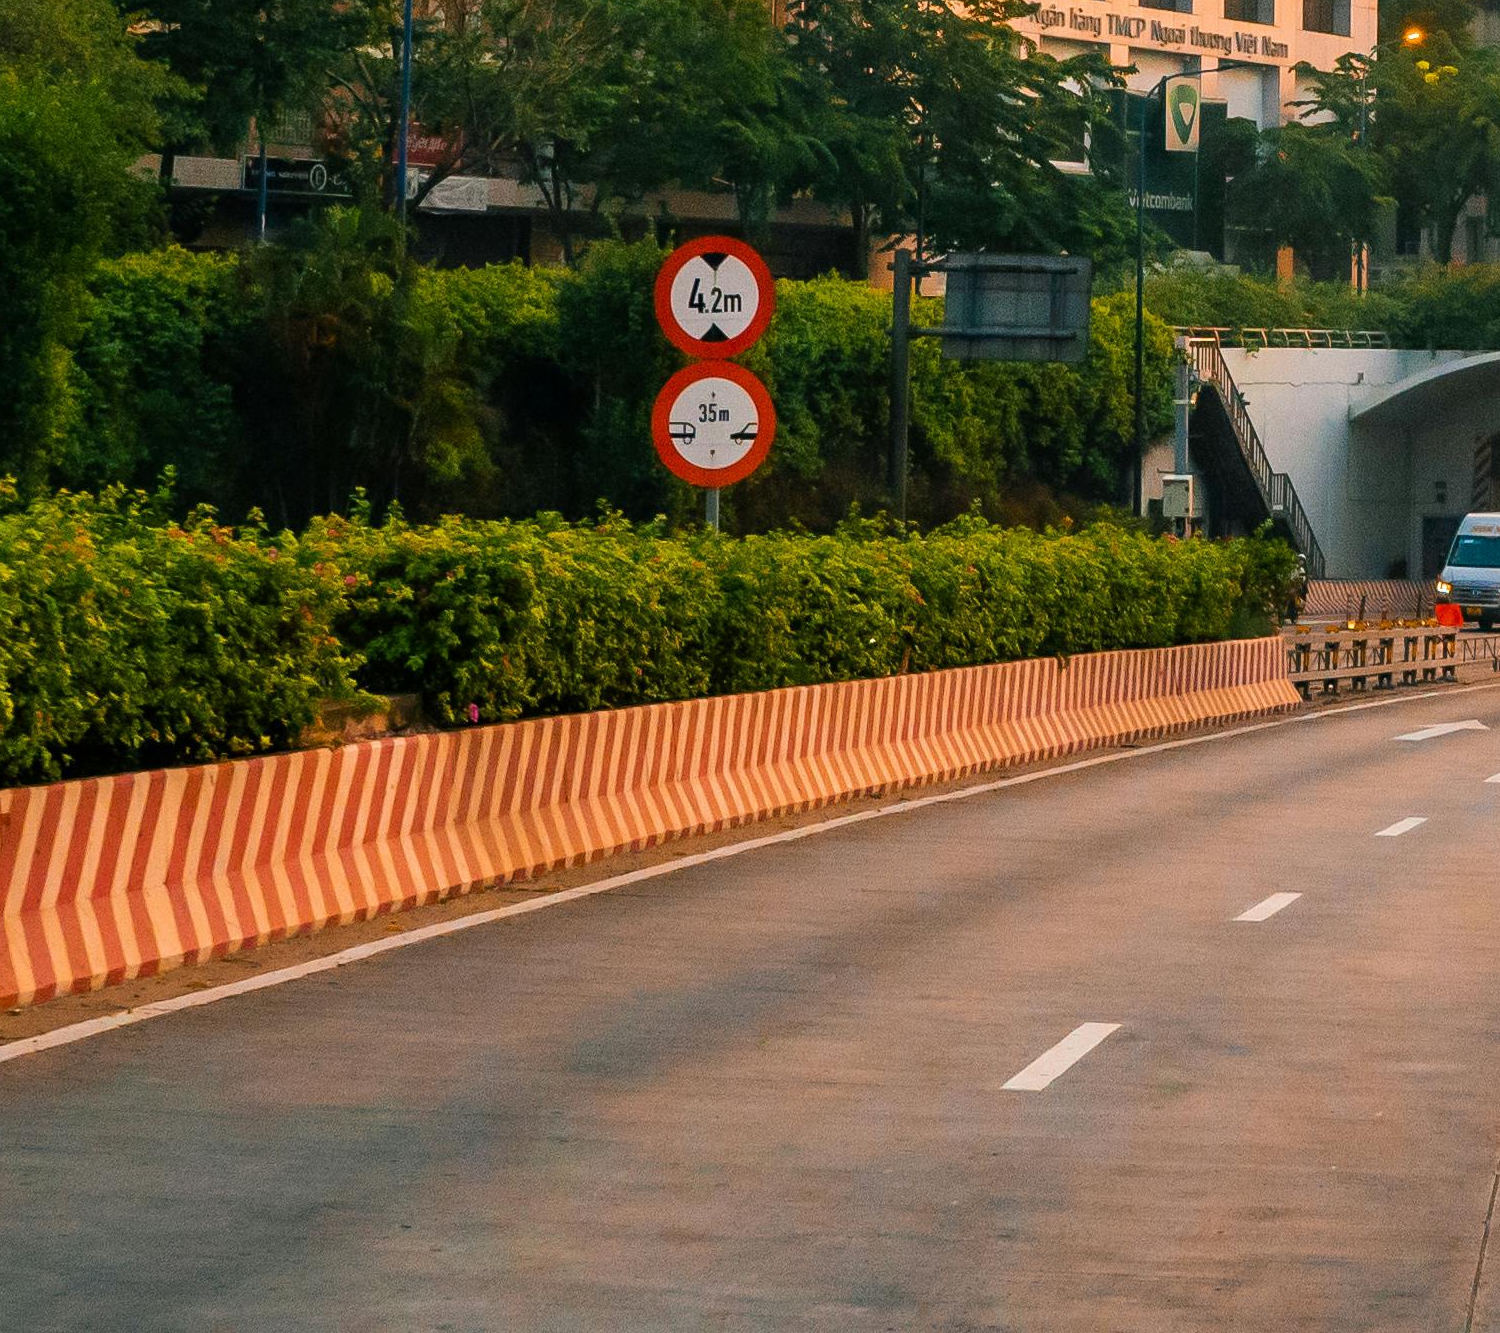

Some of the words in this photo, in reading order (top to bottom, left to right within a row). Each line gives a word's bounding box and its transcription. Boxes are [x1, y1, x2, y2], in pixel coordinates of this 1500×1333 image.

[1106, 12, 1146, 39] TMCP
[1261, 35, 1289, 59] Nam
[1128, 188, 1193, 211] Vitcombank
[688, 277, 742, 314] 4.2m
